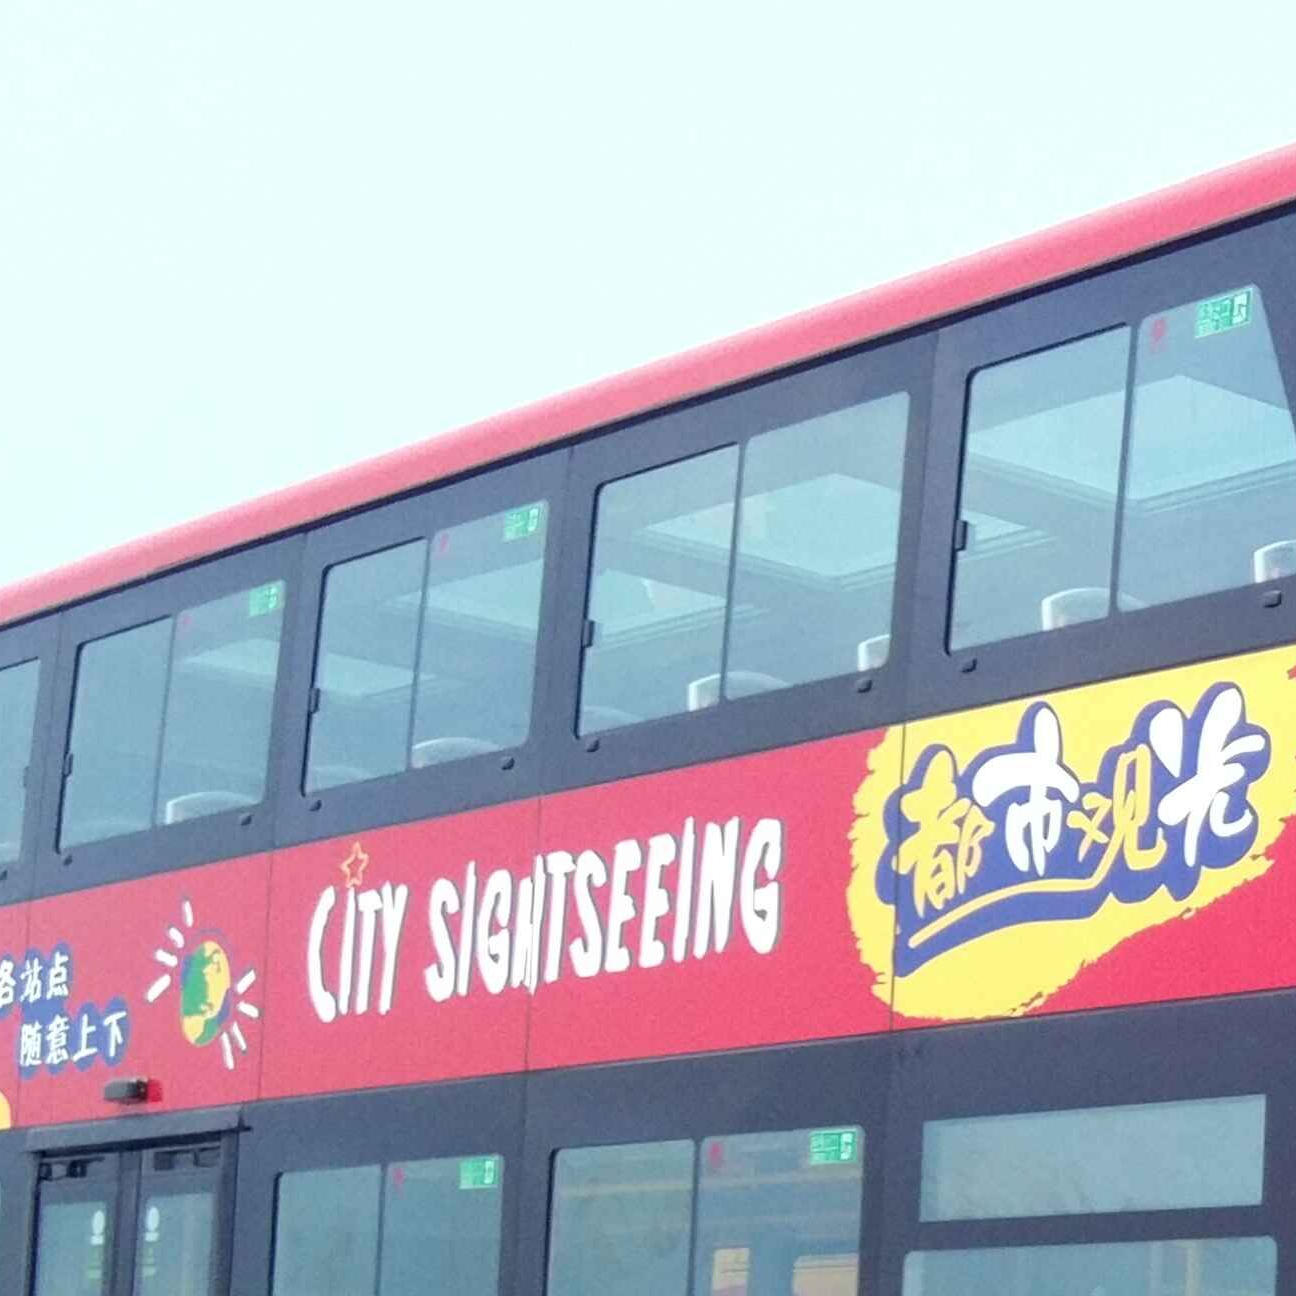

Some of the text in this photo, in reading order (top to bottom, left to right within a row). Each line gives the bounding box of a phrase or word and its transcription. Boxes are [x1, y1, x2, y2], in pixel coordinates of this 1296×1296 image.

[307, 816, 783, 1023] CITY SIGHTSEEING
[891, 685, 1267, 947] 都市观光
[19, 1011, 128, 1068] 随意上下
